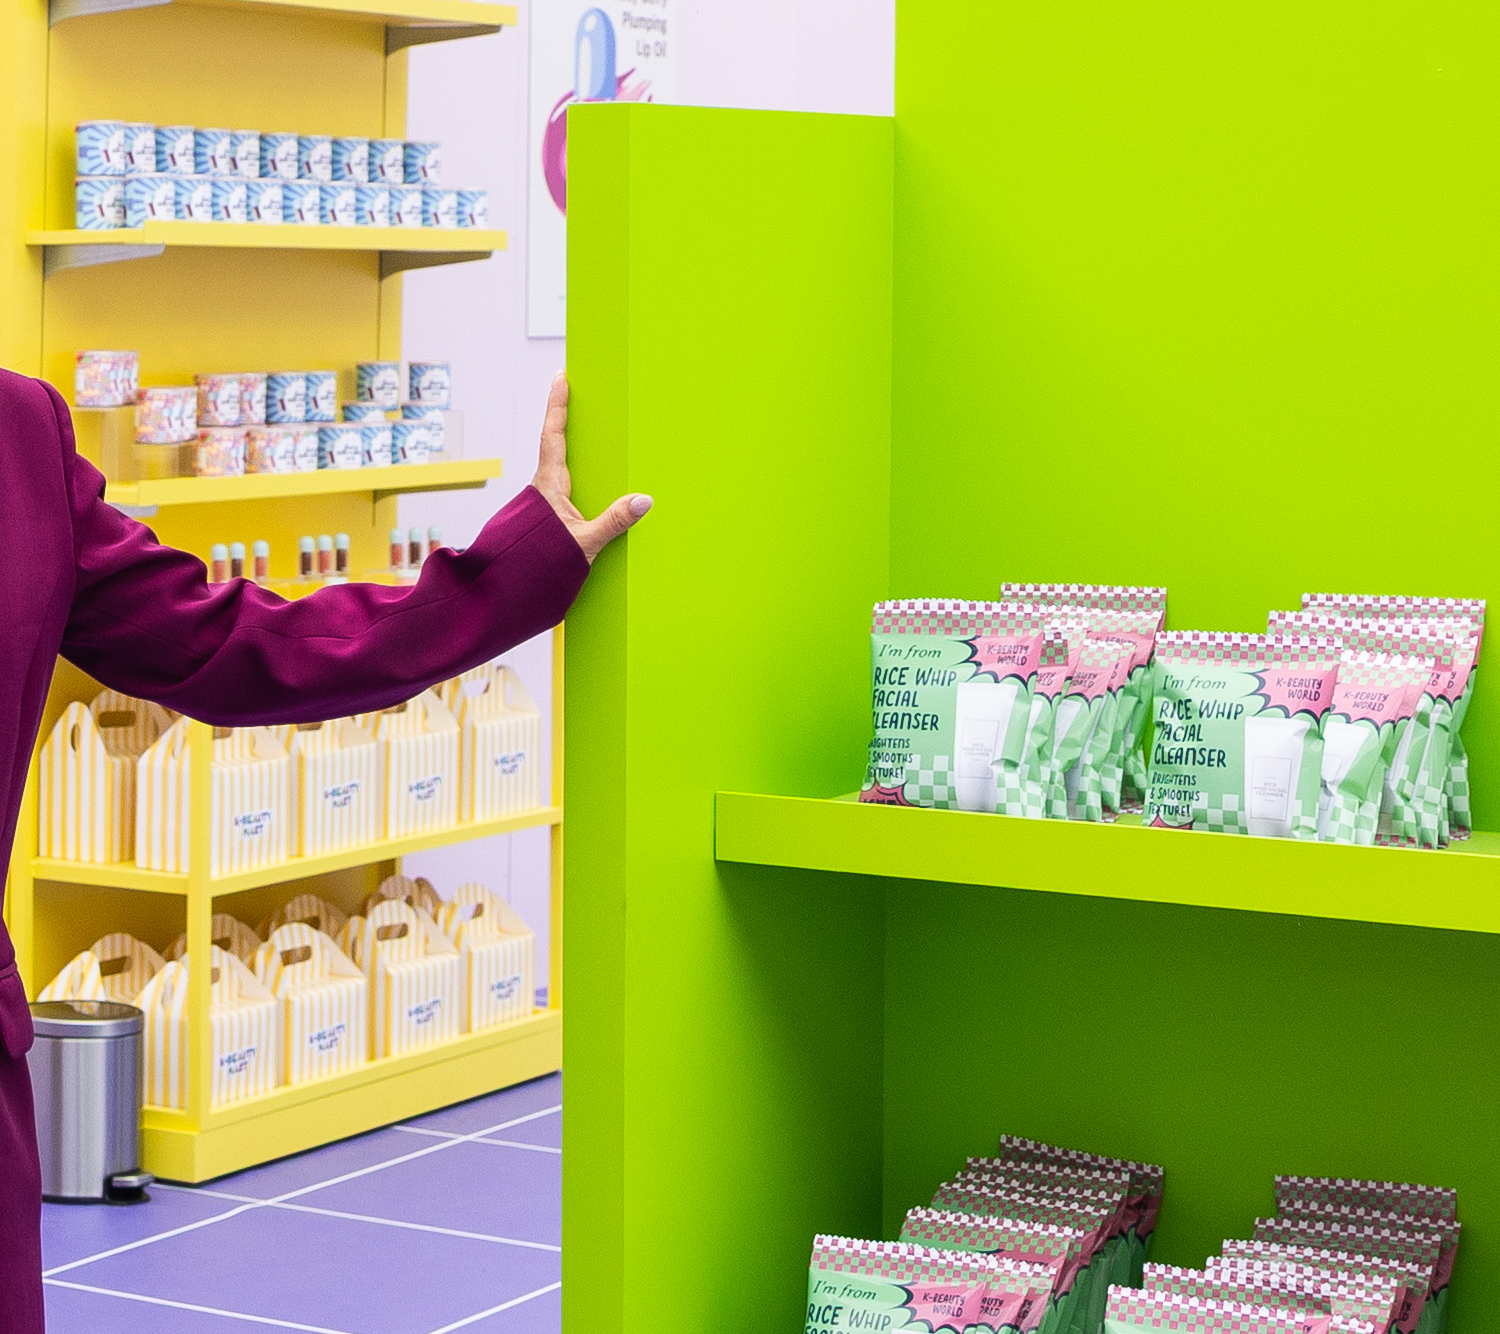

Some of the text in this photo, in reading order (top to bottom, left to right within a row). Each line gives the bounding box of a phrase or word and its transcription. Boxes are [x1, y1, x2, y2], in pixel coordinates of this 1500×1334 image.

[1186, 676, 1226, 691] from
[1276, 678, 1322, 689] K-BEAUTY
[1288, 689, 1320, 701] WORLD
[1160, 698, 1244, 720] RICE WHIP
[1154, 744, 1226, 767] CLEANSER
[1152, 772, 1196, 786] BRIGHTENS
[1158, 788, 1200, 801] SMOOTHS
